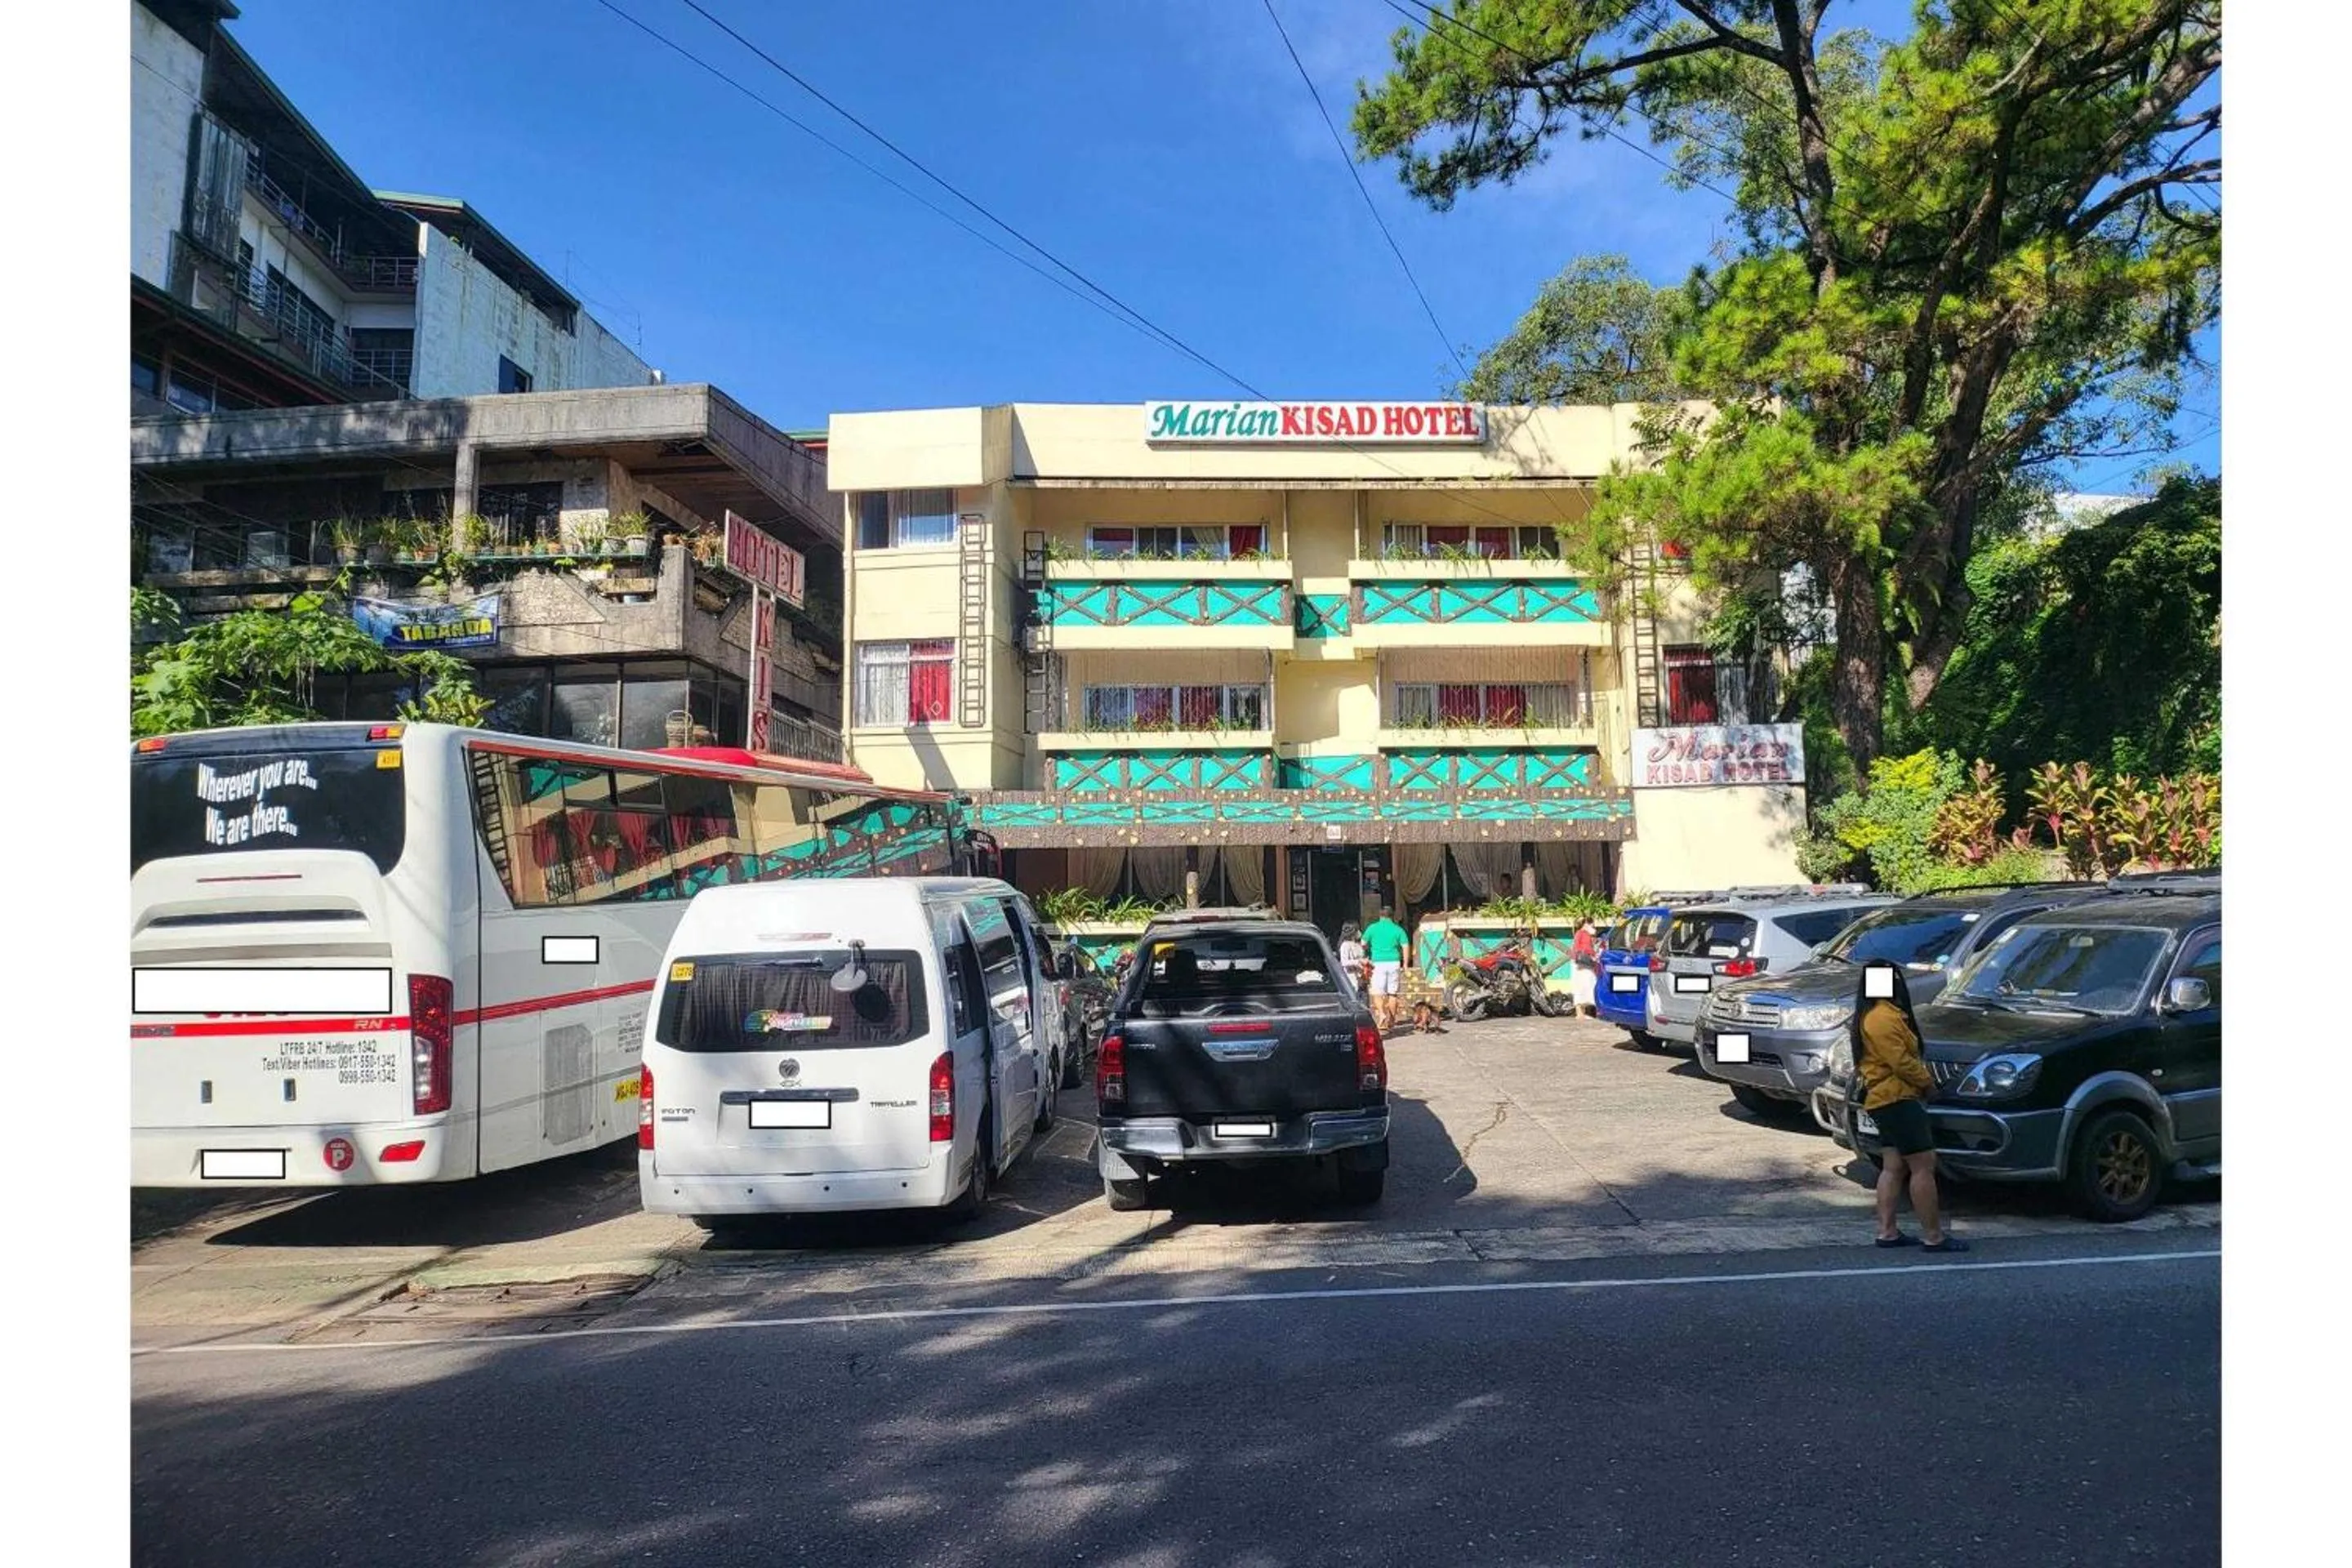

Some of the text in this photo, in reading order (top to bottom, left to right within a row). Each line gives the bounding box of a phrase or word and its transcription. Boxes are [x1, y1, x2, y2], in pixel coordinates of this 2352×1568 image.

[1151, 403, 1479, 438] Marian KISAD HOTEL
[728, 516, 802, 599] HOTEL
[1648, 731, 1789, 763] Marian
[198, 762, 258, 802] Wherever
[256, 760, 284, 801] you
[1646, 760, 1793, 784] KISAD HOTEL
[206, 806, 225, 845] We
[226, 815, 250, 845] are
[280, 1042, 305, 1056] LTFRB
[358, 1039, 376, 1054] 1342
